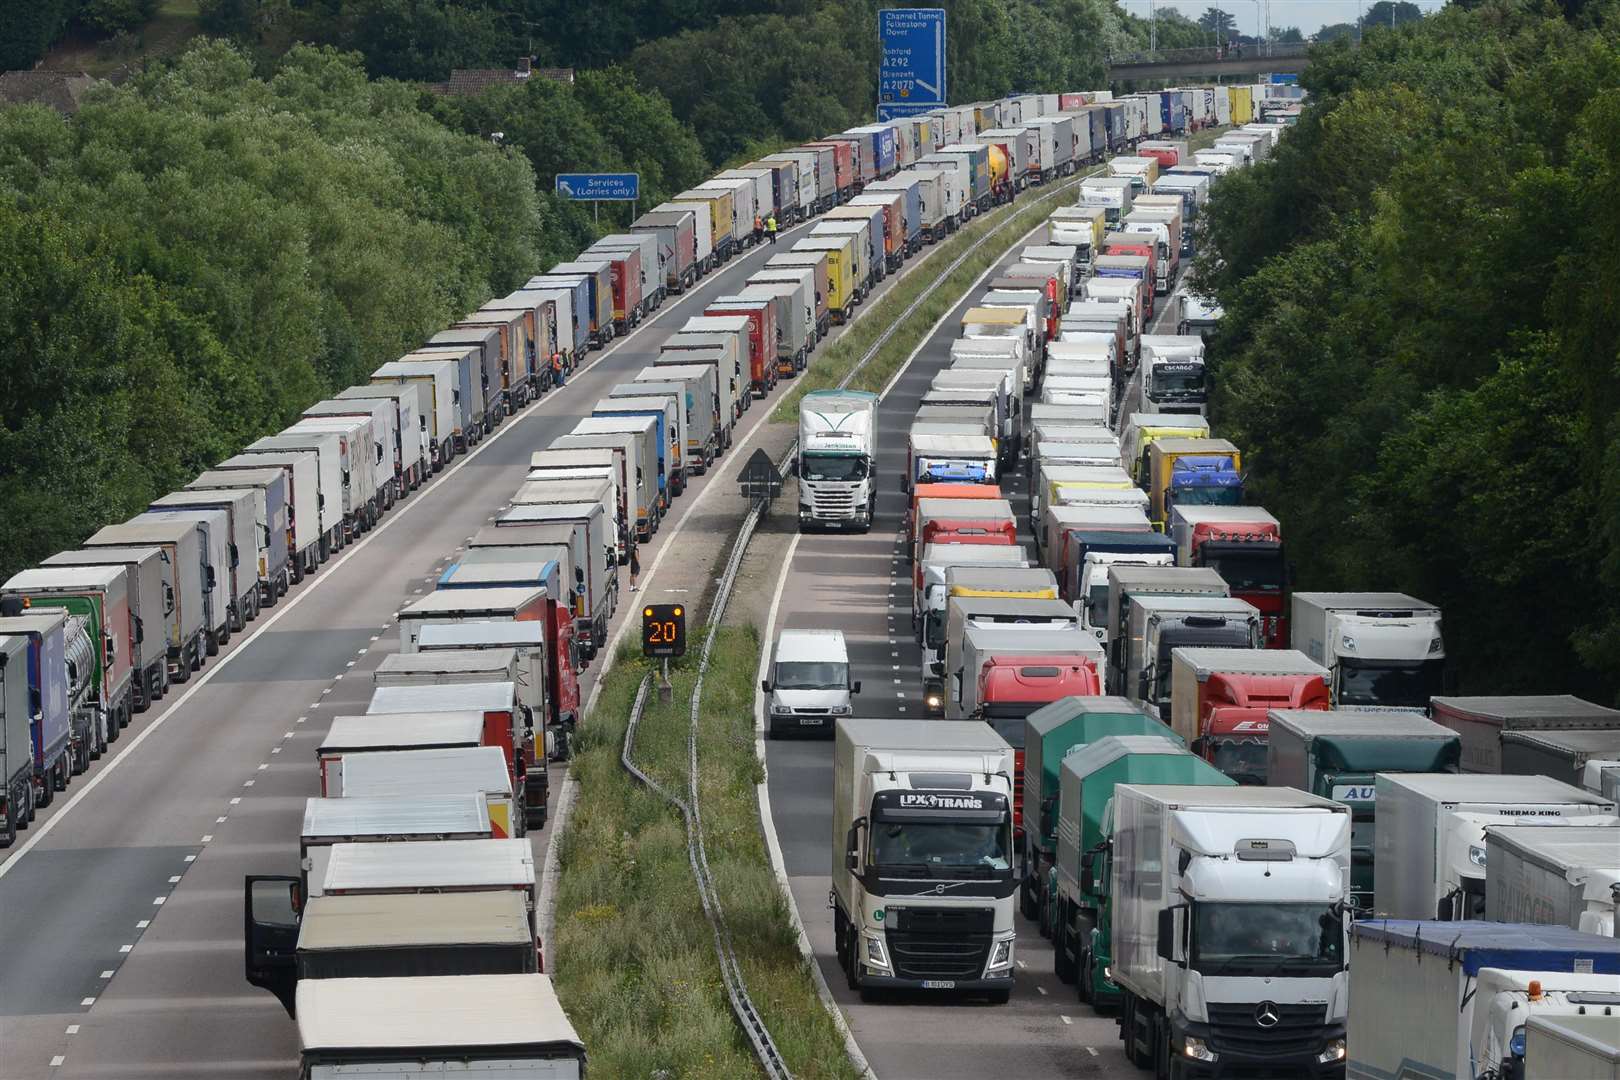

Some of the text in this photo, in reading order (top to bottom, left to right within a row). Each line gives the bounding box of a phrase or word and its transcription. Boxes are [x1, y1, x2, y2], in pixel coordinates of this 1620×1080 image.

[886, 12, 916, 20] Channel
[886, 20, 927, 28] Folkestone
[588, 179, 624, 187] Services
[577, 187, 635, 196] (Lorries only)
[649, 622, 676, 642] 20
[900, 795, 983, 809] LPX TRANS
